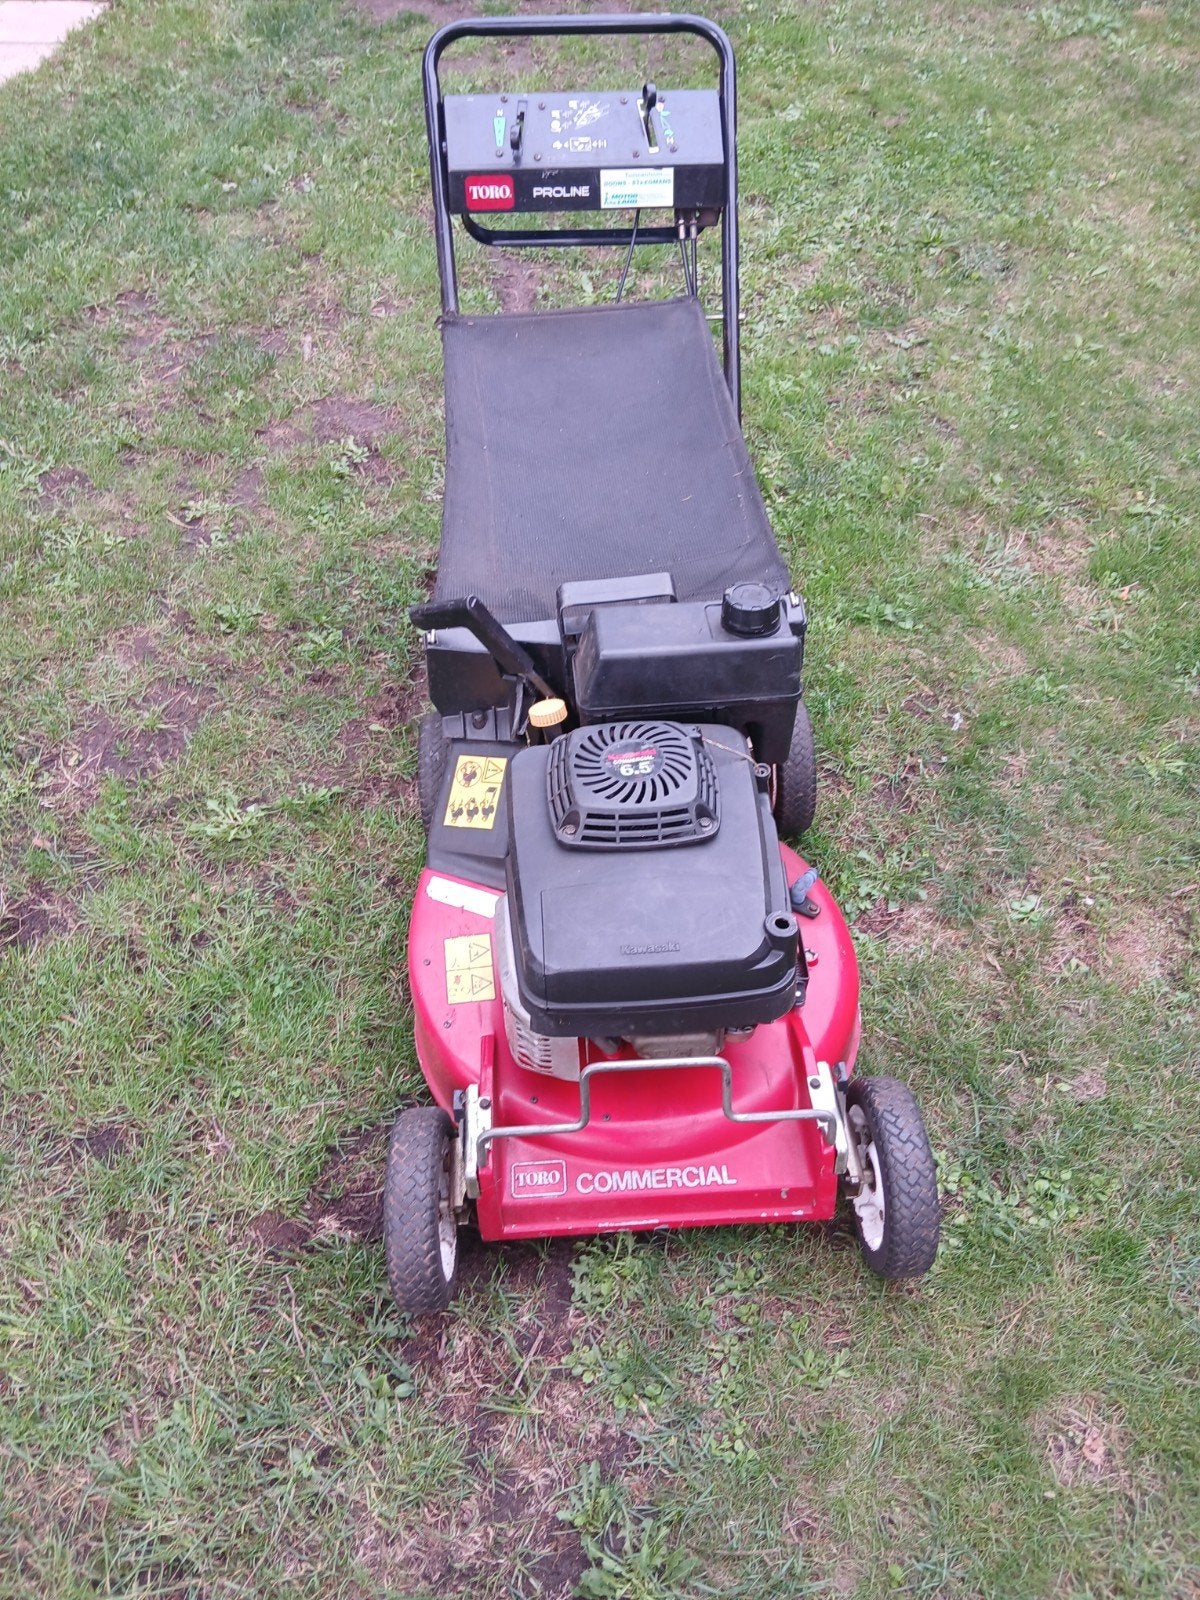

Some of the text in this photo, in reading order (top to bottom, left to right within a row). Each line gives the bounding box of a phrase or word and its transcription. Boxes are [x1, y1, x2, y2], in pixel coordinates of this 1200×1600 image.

[469, 184, 512, 200] TORO
[532, 185, 590, 199] PROLINE
[620, 760, 653, 777] 6.5
[620, 939, 680, 955] Kawasaki
[515, 1165, 737, 1194] TORO COMMERCIAL
